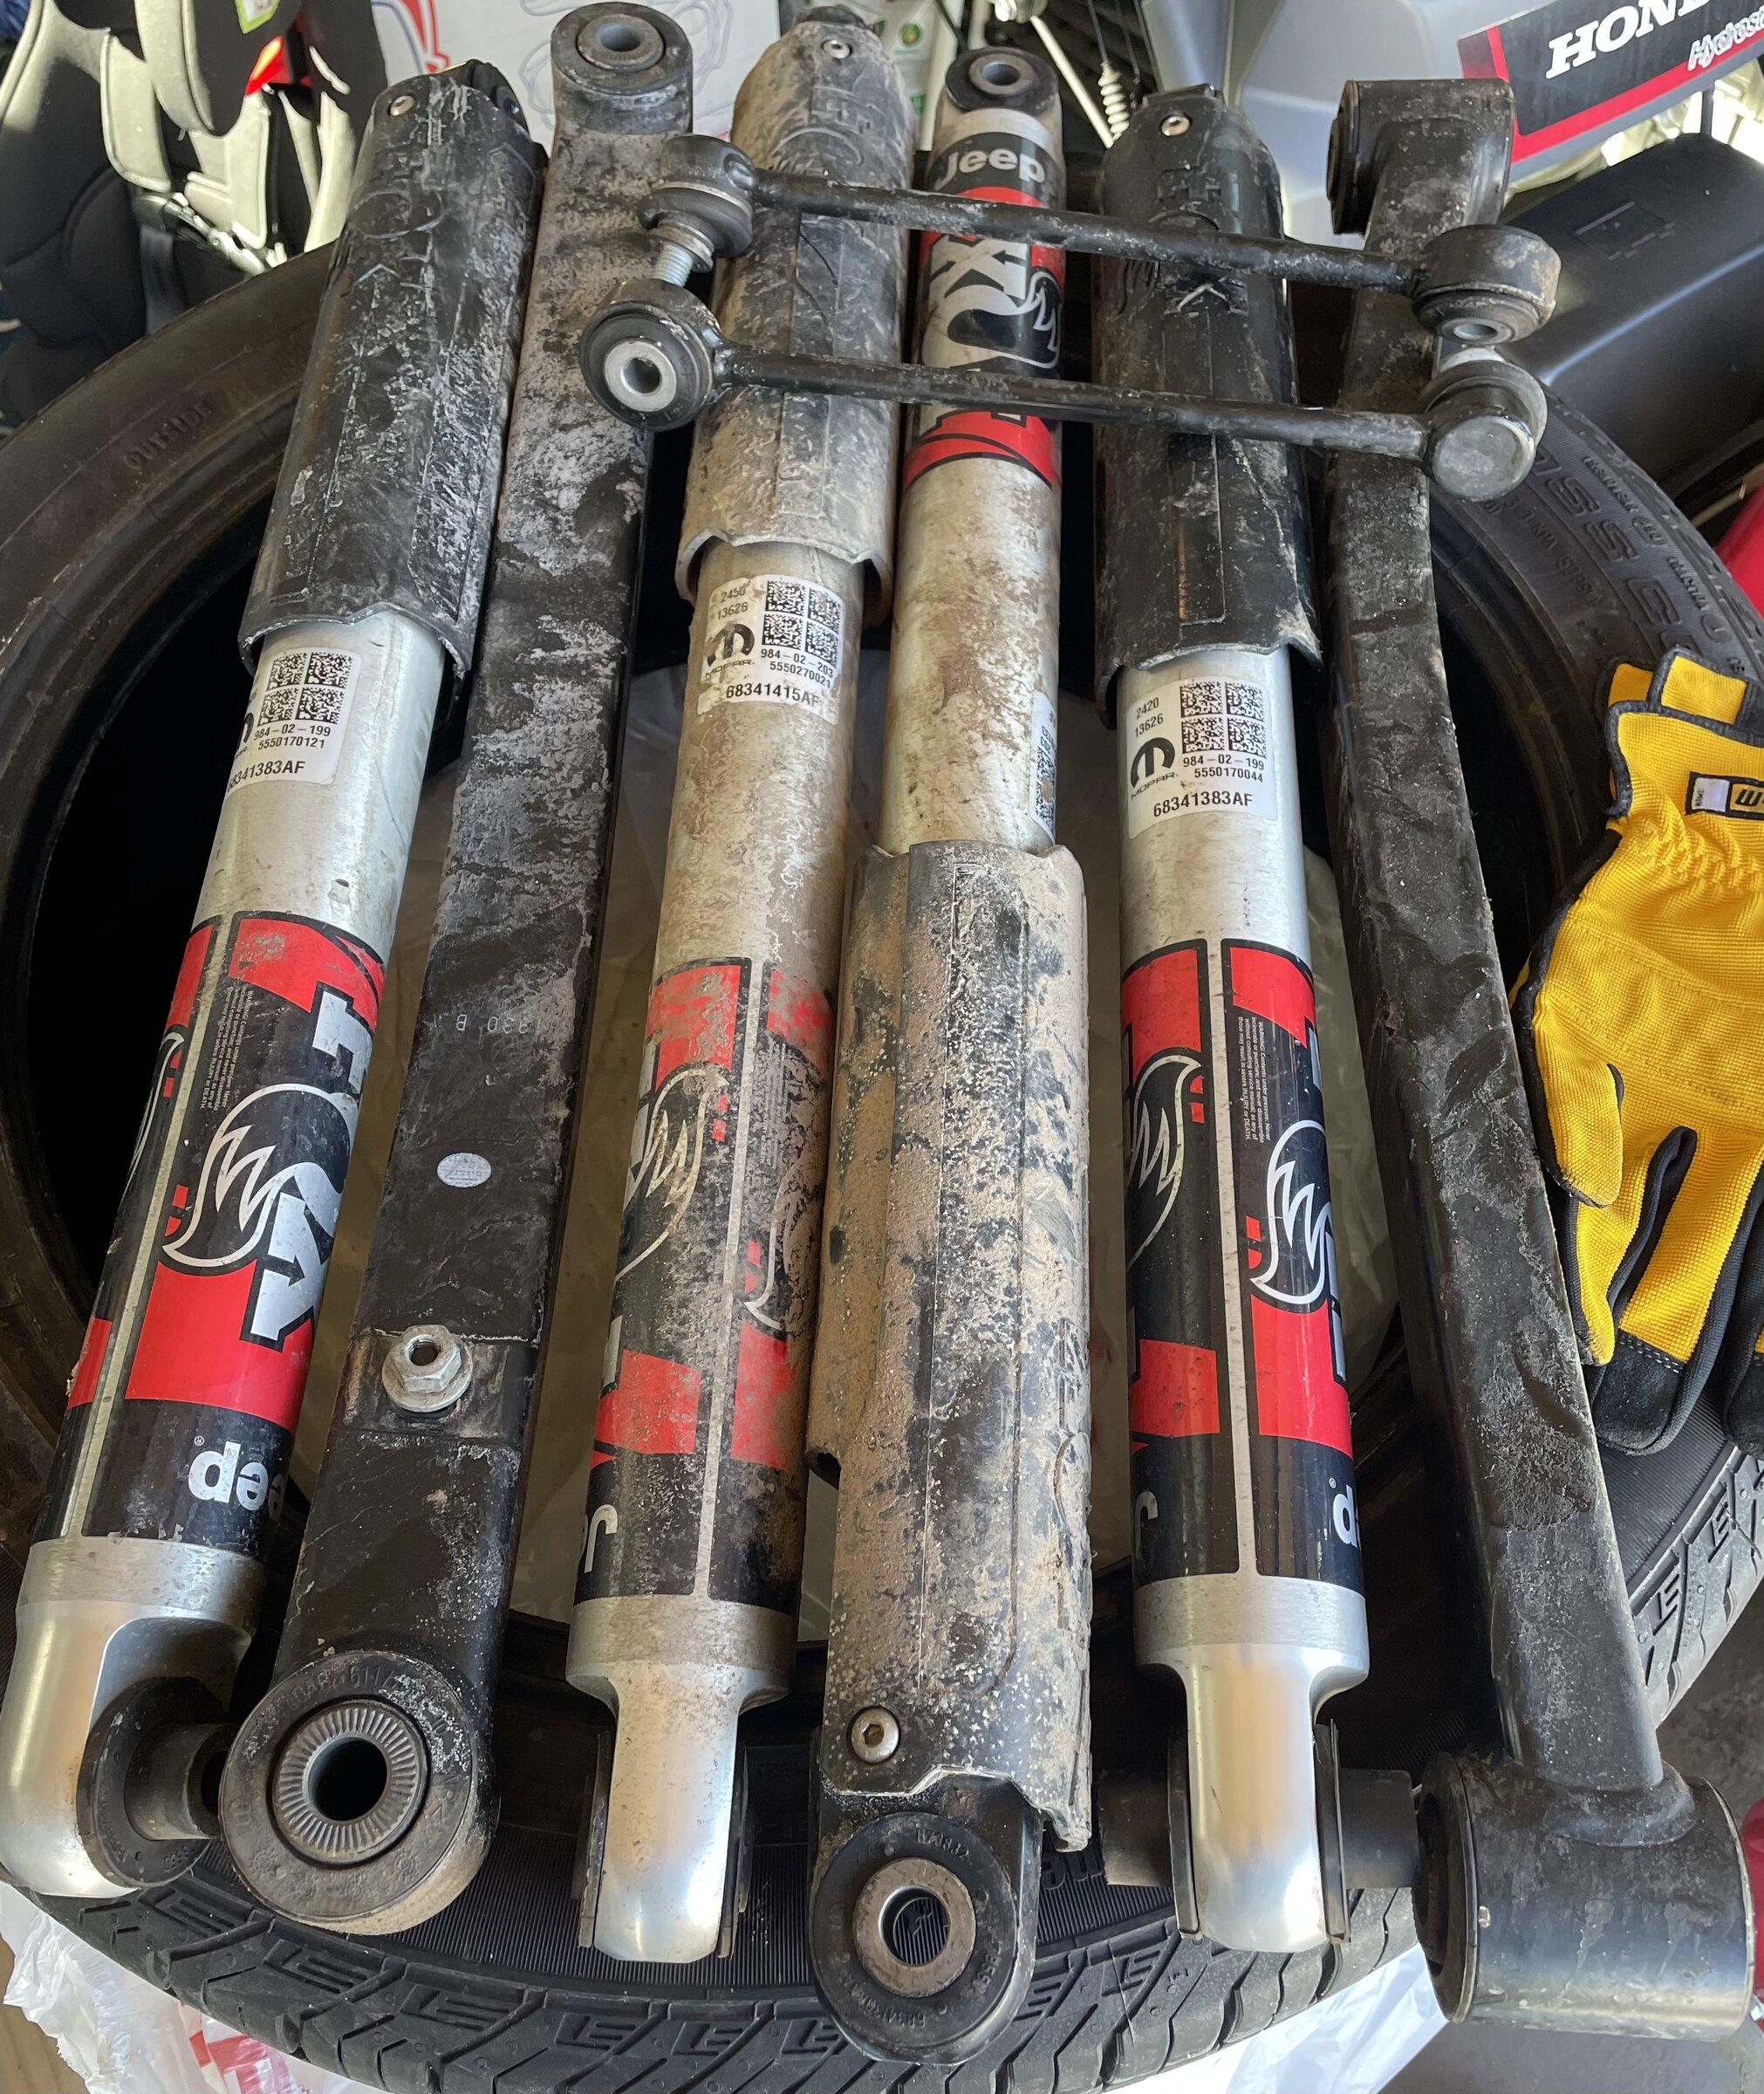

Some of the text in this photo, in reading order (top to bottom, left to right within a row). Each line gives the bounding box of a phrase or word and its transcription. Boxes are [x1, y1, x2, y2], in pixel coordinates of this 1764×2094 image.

[934, 148, 1045, 191] Jeep
[718, 601, 749, 620] 13626
[726, 682, 821, 707] 68341415AF
[1136, 697, 1159, 719] 2420
[1135, 713, 1164, 738] 13626
[258, 736, 325, 750] 5550170121
[1131, 771, 1175, 800] MOPAR
[1194, 767, 1264, 784] 5550170044
[1153, 790, 1253, 818] 68341383AF
